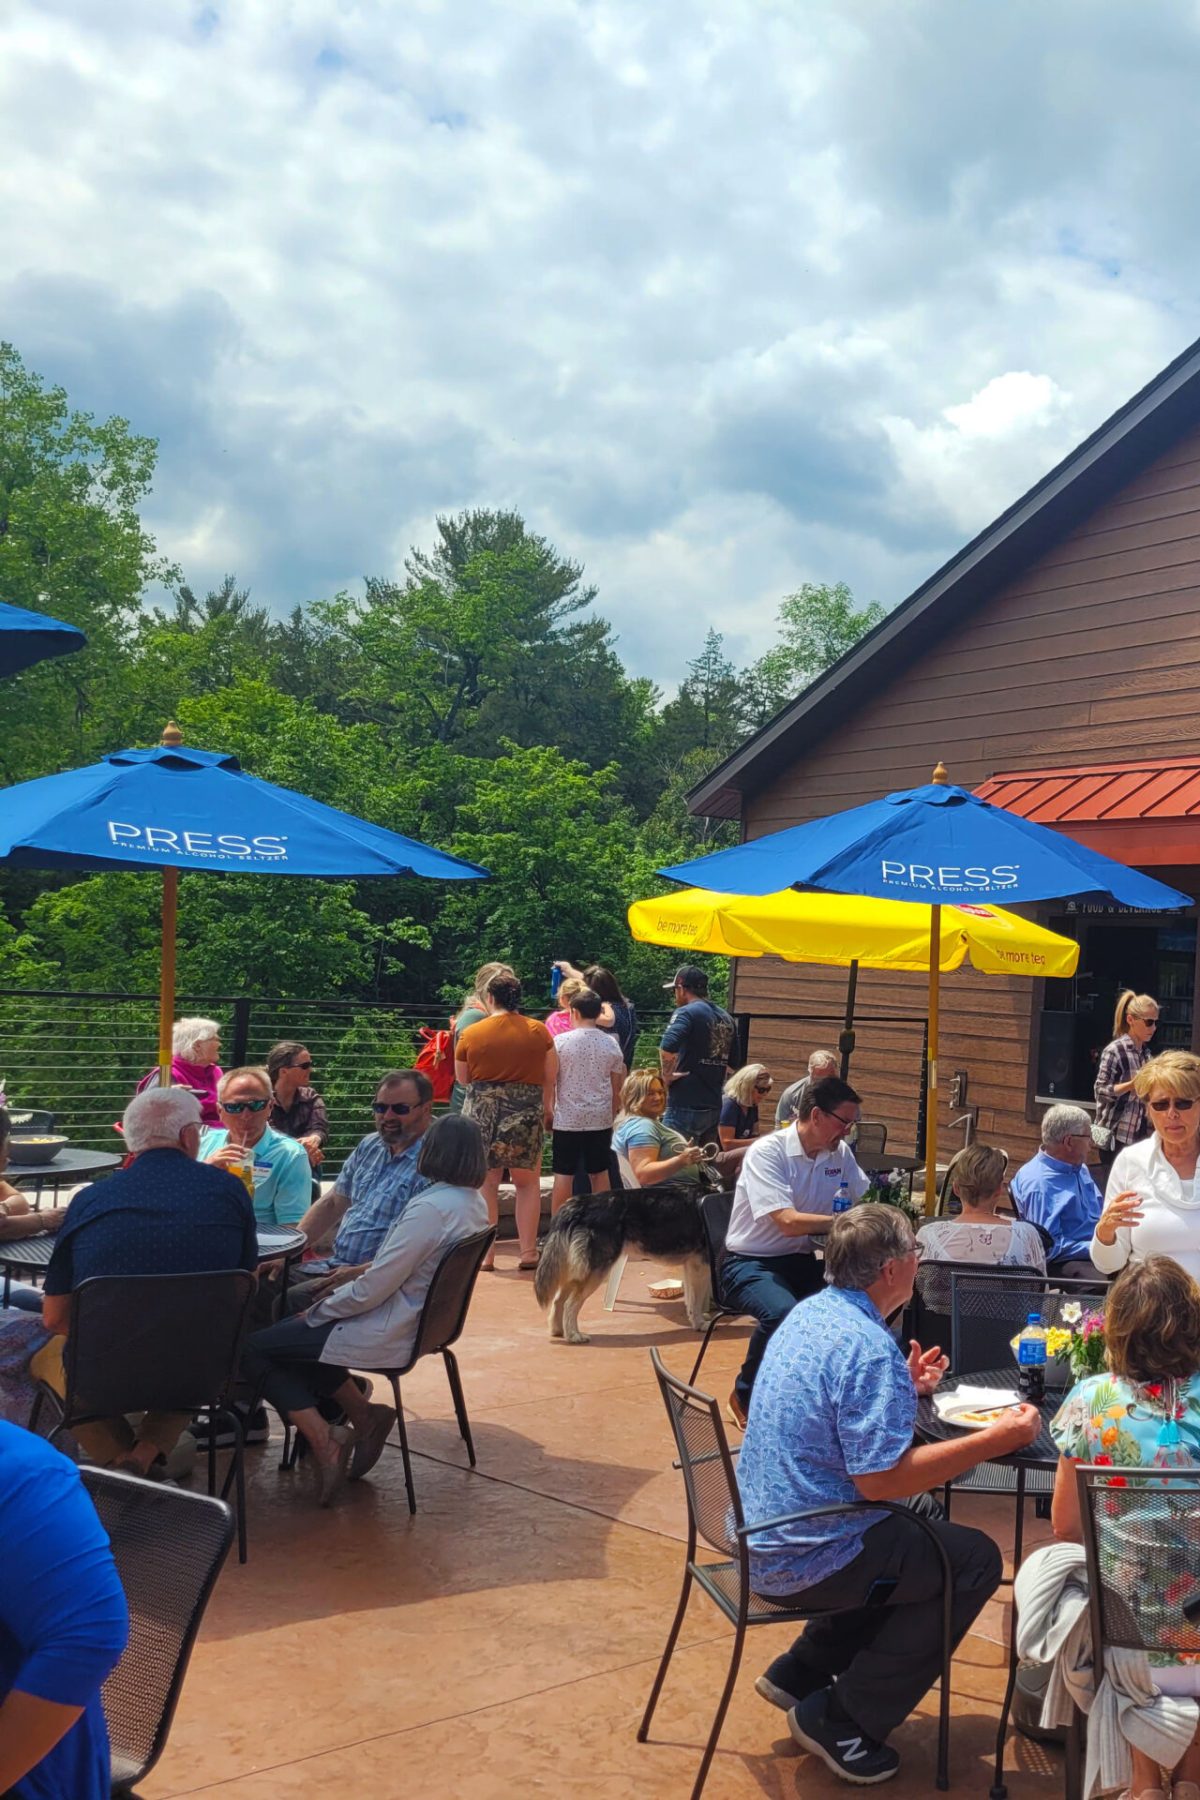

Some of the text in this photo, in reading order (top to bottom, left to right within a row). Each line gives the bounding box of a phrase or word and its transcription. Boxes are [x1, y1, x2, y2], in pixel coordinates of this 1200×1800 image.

[108, 821, 288, 856] PRESS
[112, 841, 171, 853] PREMIUM
[176, 849, 232, 859] ALCOHOL
[881, 860, 1020, 887] PRESS
